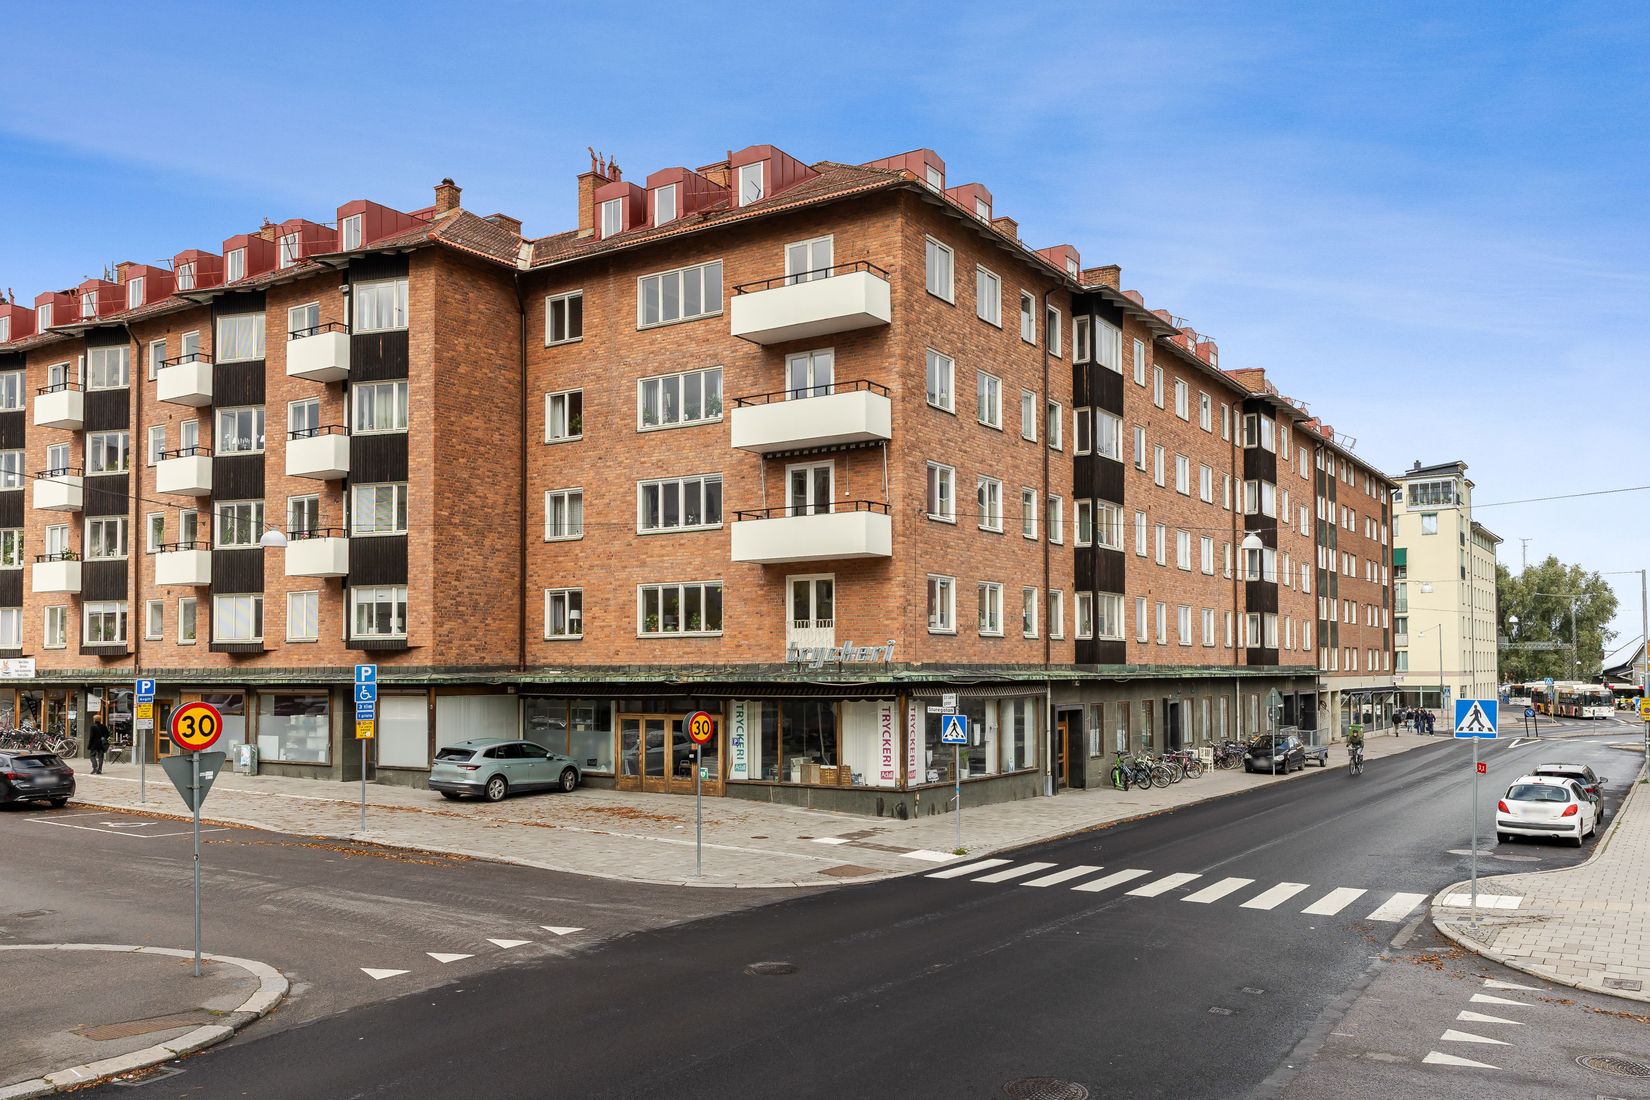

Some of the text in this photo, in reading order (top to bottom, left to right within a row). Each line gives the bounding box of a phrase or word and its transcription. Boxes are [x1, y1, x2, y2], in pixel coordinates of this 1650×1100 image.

[787, 640, 896, 669] tryckeri
[141, 680, 152, 694] P
[361, 666, 372, 682] P
[181, 714, 215, 738] 30
[694, 720, 710, 736] 30
[736, 703, 745, 760] TRYCKERI
[882, 705, 892, 767] TRYCKERI
[909, 705, 917, 767] TRYCKERI
